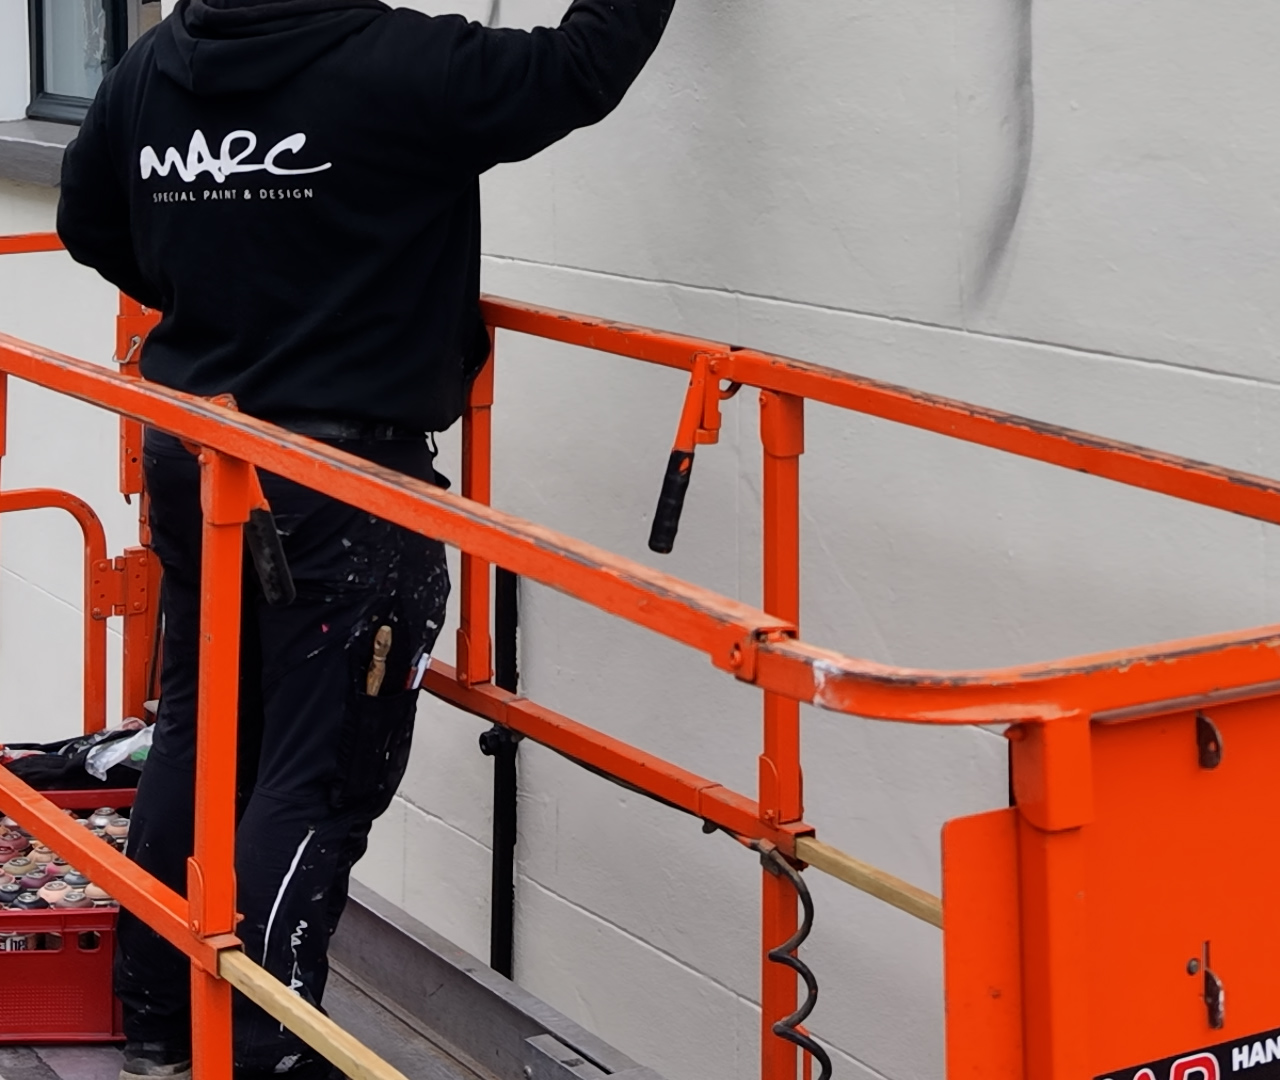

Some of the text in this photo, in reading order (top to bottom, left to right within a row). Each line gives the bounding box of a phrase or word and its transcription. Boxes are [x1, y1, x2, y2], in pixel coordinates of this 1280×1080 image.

[140, 129, 332, 183] MARC
[153, 188, 314, 203] SPECIAL PAINT & DESIGN
